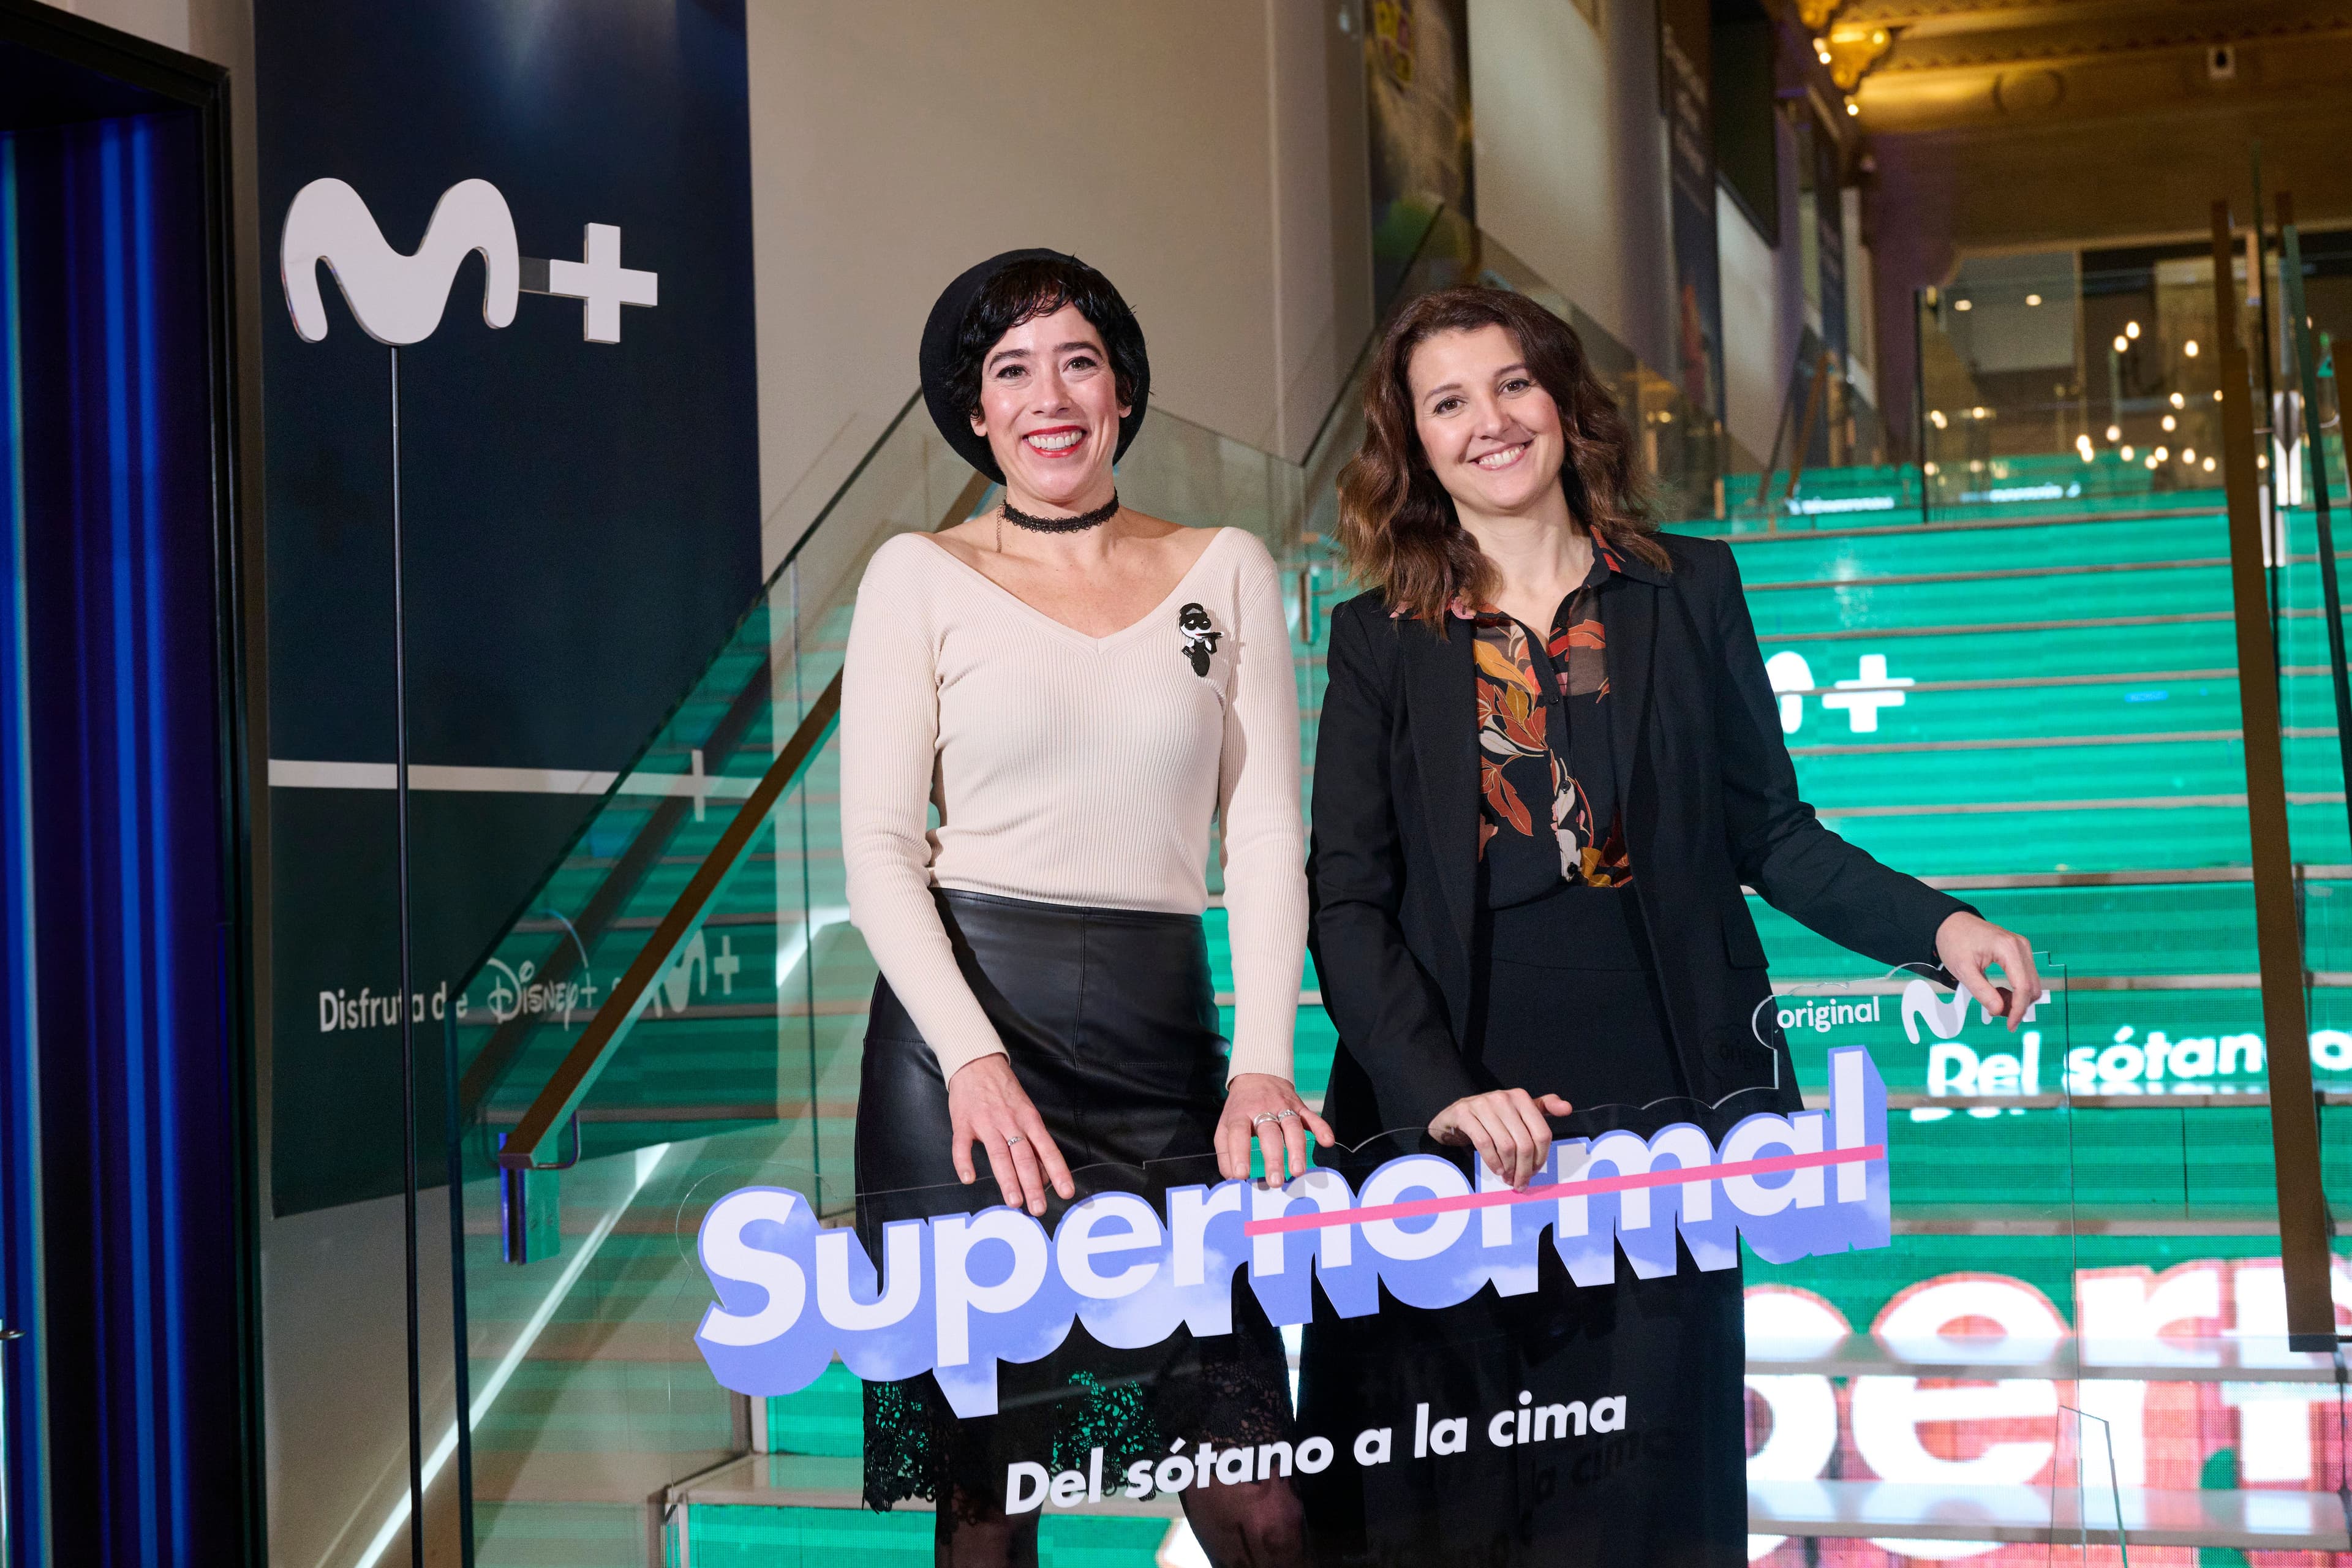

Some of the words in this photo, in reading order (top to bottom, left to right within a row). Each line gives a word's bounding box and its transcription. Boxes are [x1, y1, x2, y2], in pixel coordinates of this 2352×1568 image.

[432, 981, 469, 1020] de
[1777, 996, 1880, 1033] original
[1922, 1031, 2041, 1112] Del
[2063, 1026, 2268, 1087] sótan
[698, 1047, 1873, 1372] Supernormal
[1006, 1447, 1102, 1515] Del
[1126, 1438, 1335, 1499] sótano
[1353, 1427, 1392, 1467] a
[1414, 1403, 1468, 1458] la
[1488, 1390, 1627, 1447] cima
